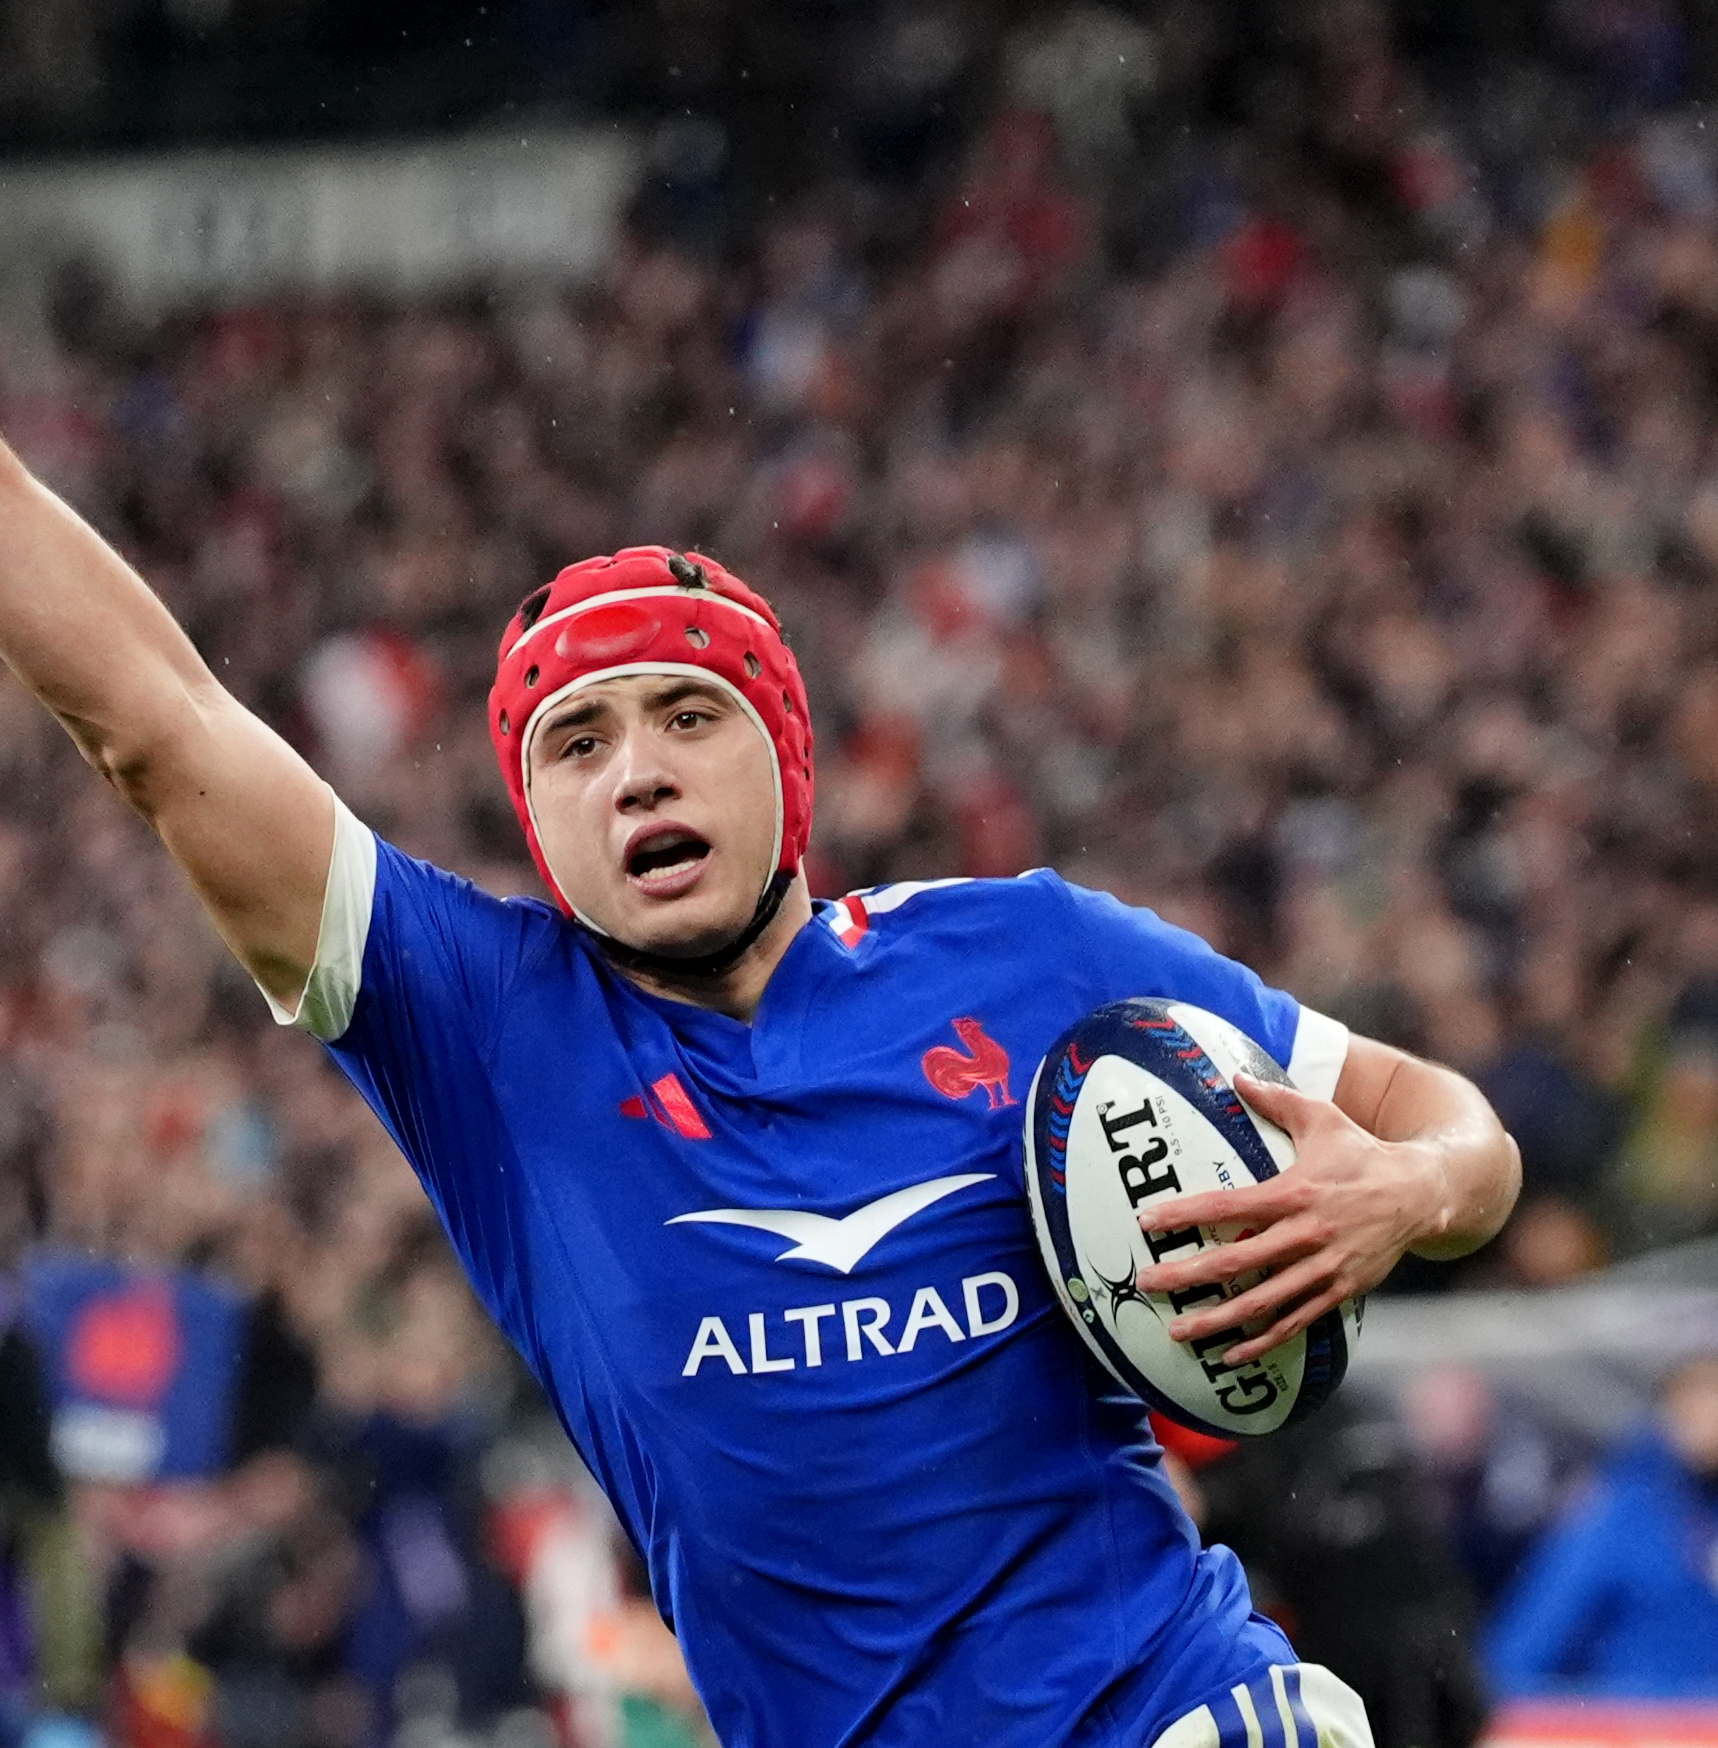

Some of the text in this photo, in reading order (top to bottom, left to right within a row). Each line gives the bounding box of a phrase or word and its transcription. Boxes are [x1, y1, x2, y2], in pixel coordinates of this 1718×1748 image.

[1155, 1095, 1167, 1114] PSI
[1162, 1116, 1172, 1129] 10
[681, 1270, 1020, 1377] ALTRAD
